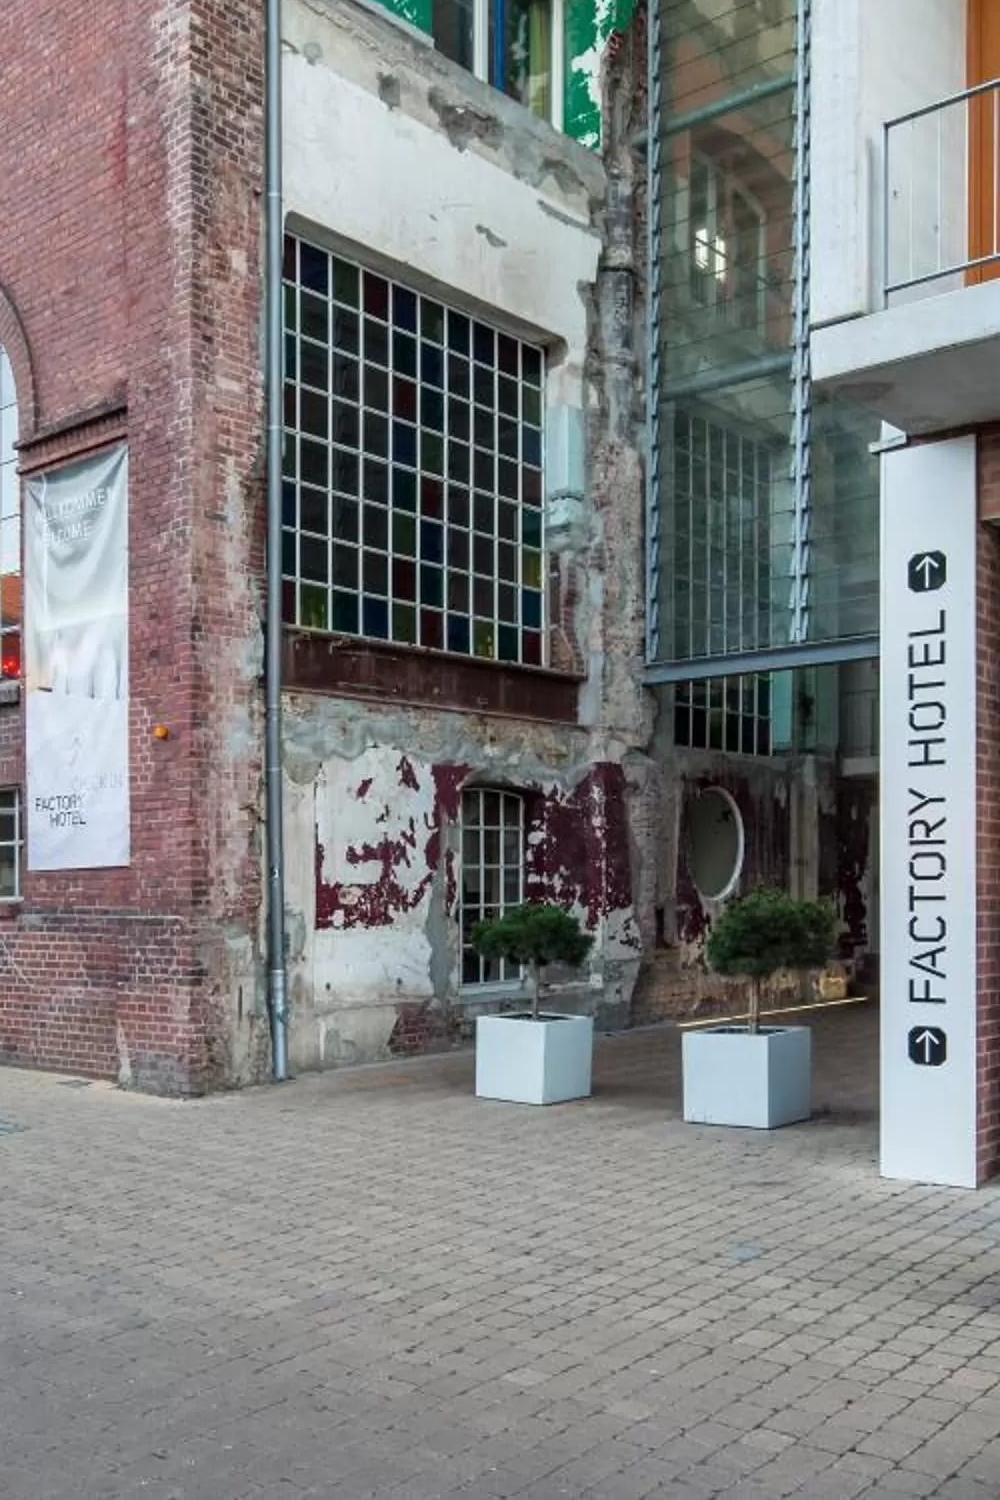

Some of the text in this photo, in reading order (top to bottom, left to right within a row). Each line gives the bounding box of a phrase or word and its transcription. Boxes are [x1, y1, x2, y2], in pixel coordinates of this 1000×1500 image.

[35, 793, 84, 813] FACTORY
[908, 609, 946, 1005] FACTORY HOTEL
[49, 810, 86, 829] HOTEL
